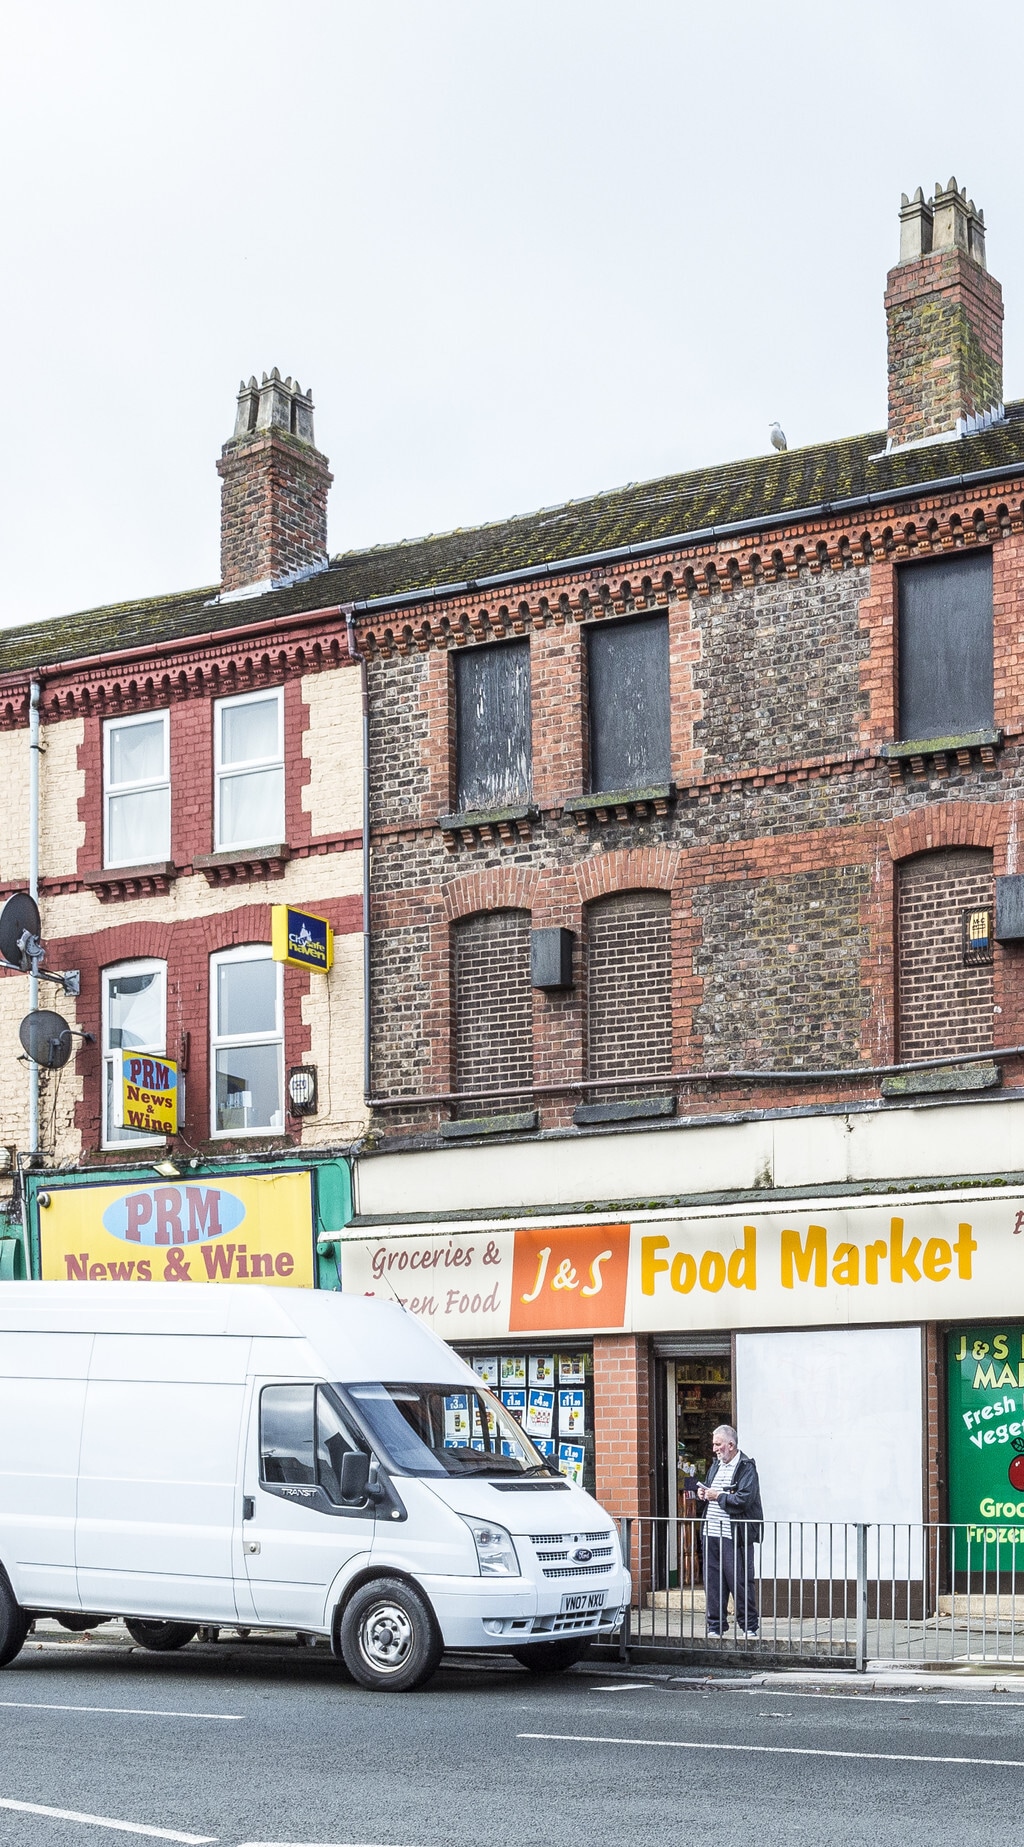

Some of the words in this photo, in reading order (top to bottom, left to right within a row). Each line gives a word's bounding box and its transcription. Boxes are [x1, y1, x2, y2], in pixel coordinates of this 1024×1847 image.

[289, 941, 325, 960] haven
[129, 1058, 170, 1090] PRM
[127, 1085, 173, 1108] News
[146, 1104, 155, 1114] &
[127, 1110, 173, 1132] Wine
[125, 1187, 222, 1244] PRM
[64, 1253, 152, 1281] News
[163, 1247, 193, 1281] &
[201, 1244, 295, 1279] Wine
[372, 1240, 475, 1279] Groceries
[483, 1240, 501, 1265] &
[641, 1225, 757, 1296] Food
[780, 1216, 978, 1289] Market
[444, 1281, 501, 1314] Food
[962, 1395, 1016, 1430] Fresh
[281, 1488, 317, 1497] TRANSIT
[565, 1596, 587, 1611] VN07
